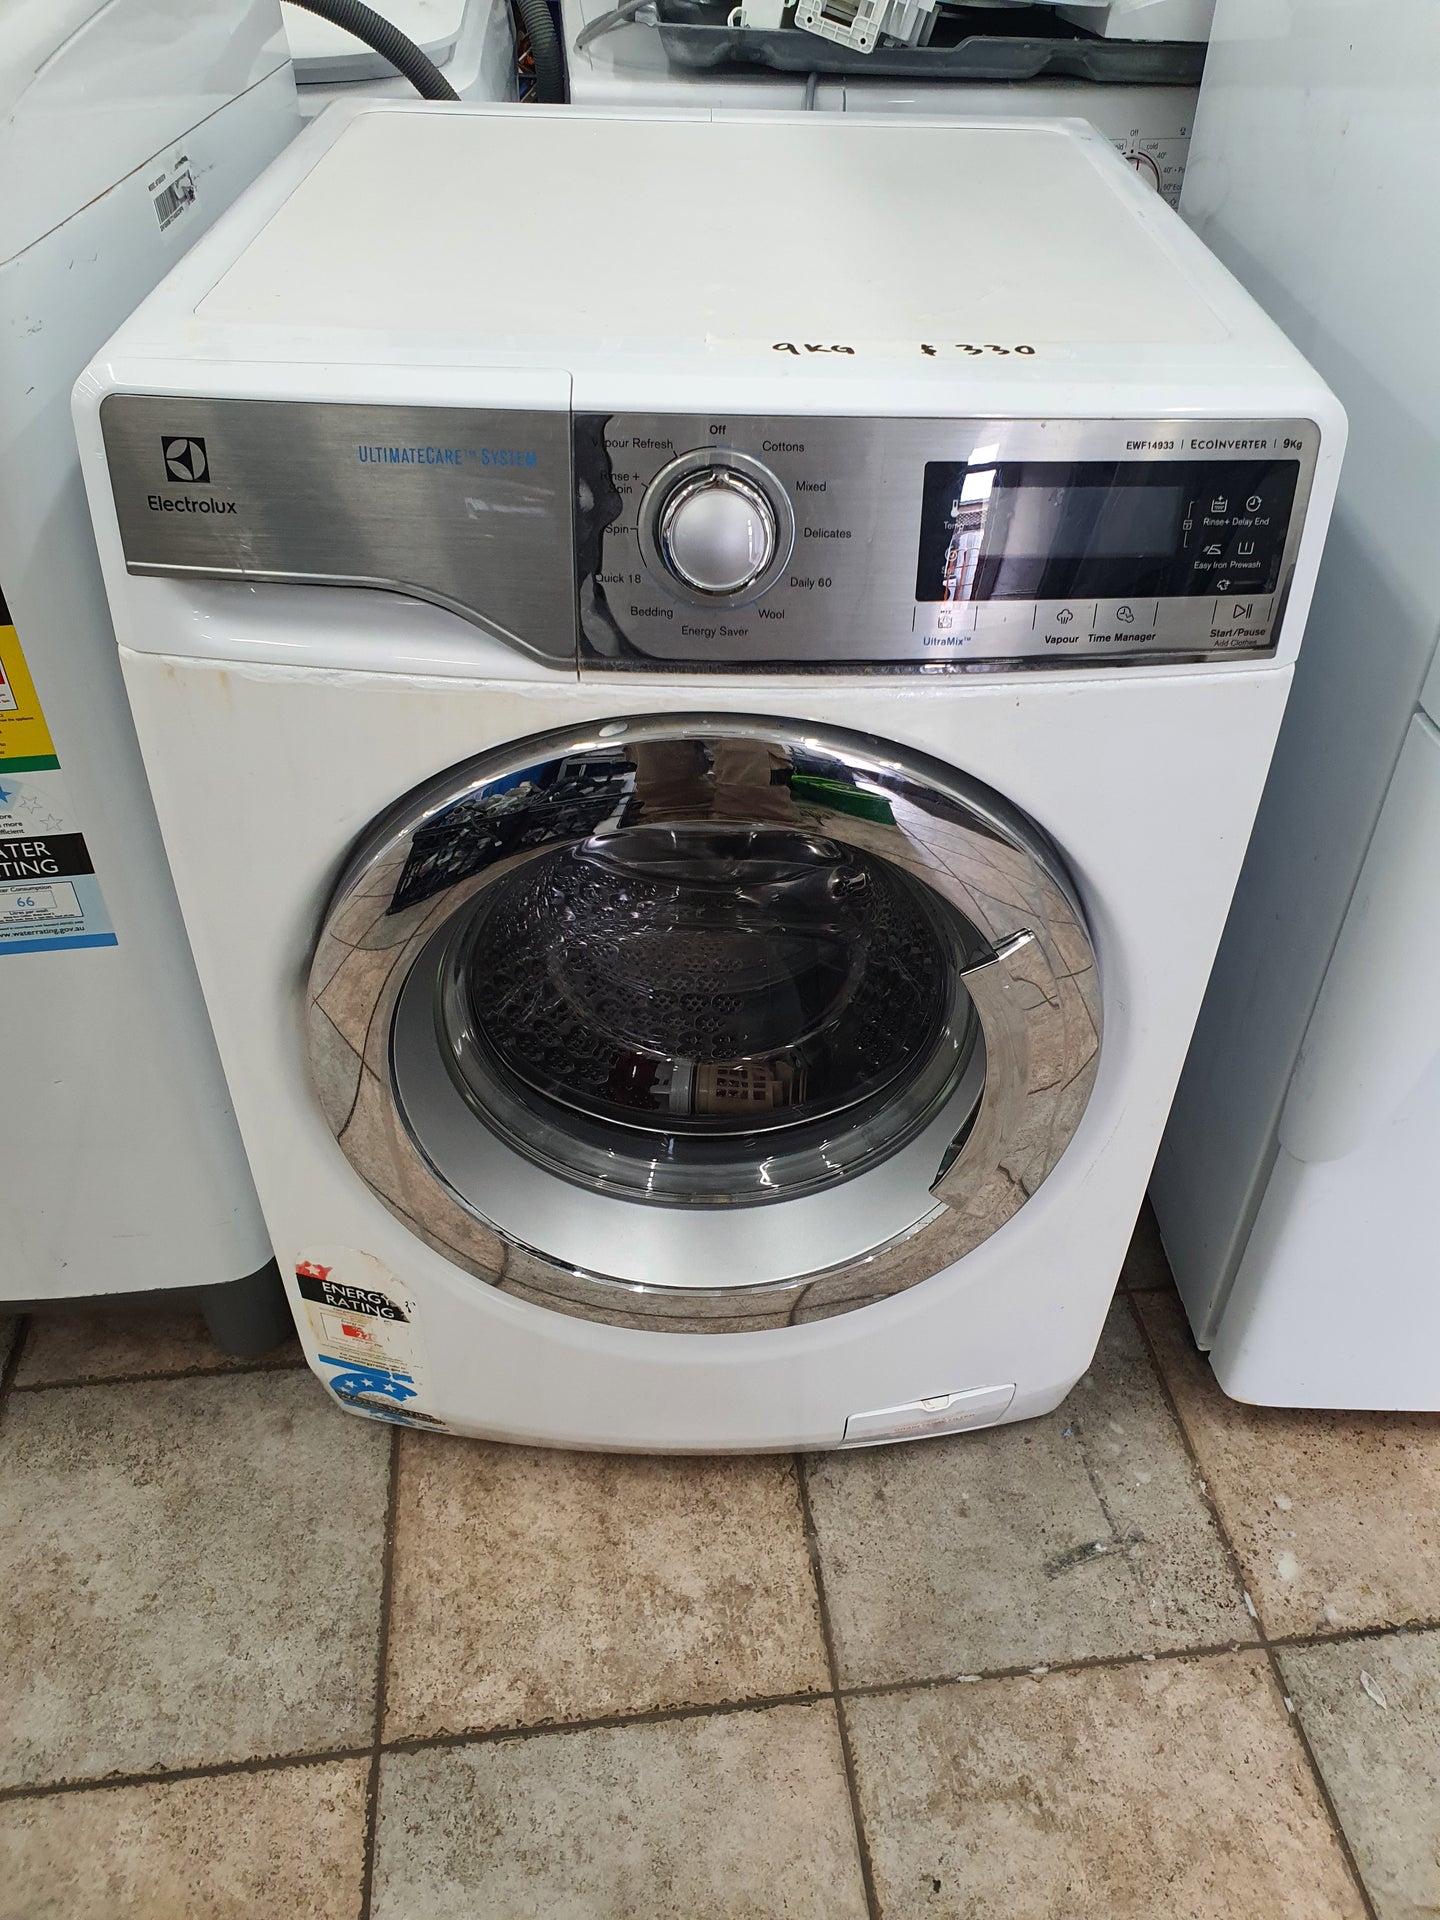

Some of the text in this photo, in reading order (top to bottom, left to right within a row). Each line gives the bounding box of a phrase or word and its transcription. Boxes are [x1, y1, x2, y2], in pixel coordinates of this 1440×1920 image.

[955, 343, 1037, 356] 330
[709, 424, 727, 436] Off
[632, 438, 674, 449] Refresh
[762, 440, 805, 452] Cottons
[1126, 440, 1175, 451] EWF14933
[1282, 438, 1303, 451] 9Kg
[795, 480, 827, 492] Mixed
[147, 495, 238, 514] Electrolux
[1232, 517, 1270, 528] Delay End
[605, 523, 629, 535] Spin
[804, 527, 852, 539] Delicates
[1194, 561, 1228, 571] Easy Iron
[1229, 560, 1261, 570] Prewash
[628, 574, 642, 584] 18
[790, 577, 832, 590] Daily 60
[630, 605, 674, 619] Bedding
[758, 609, 785, 619] Wool
[681, 625, 749, 639] Energy Saver
[1088, 631, 1156, 645] Time Manager
[1209, 627, 1266, 638] Start/Pause
[1045, 633, 1080, 645] Vapour
[1214, 639, 1229, 647] Add
[17, 896, 35, 908] 66
[321, 1281, 391, 1306] ENERGY
[325, 1294, 395, 1319] RATING
